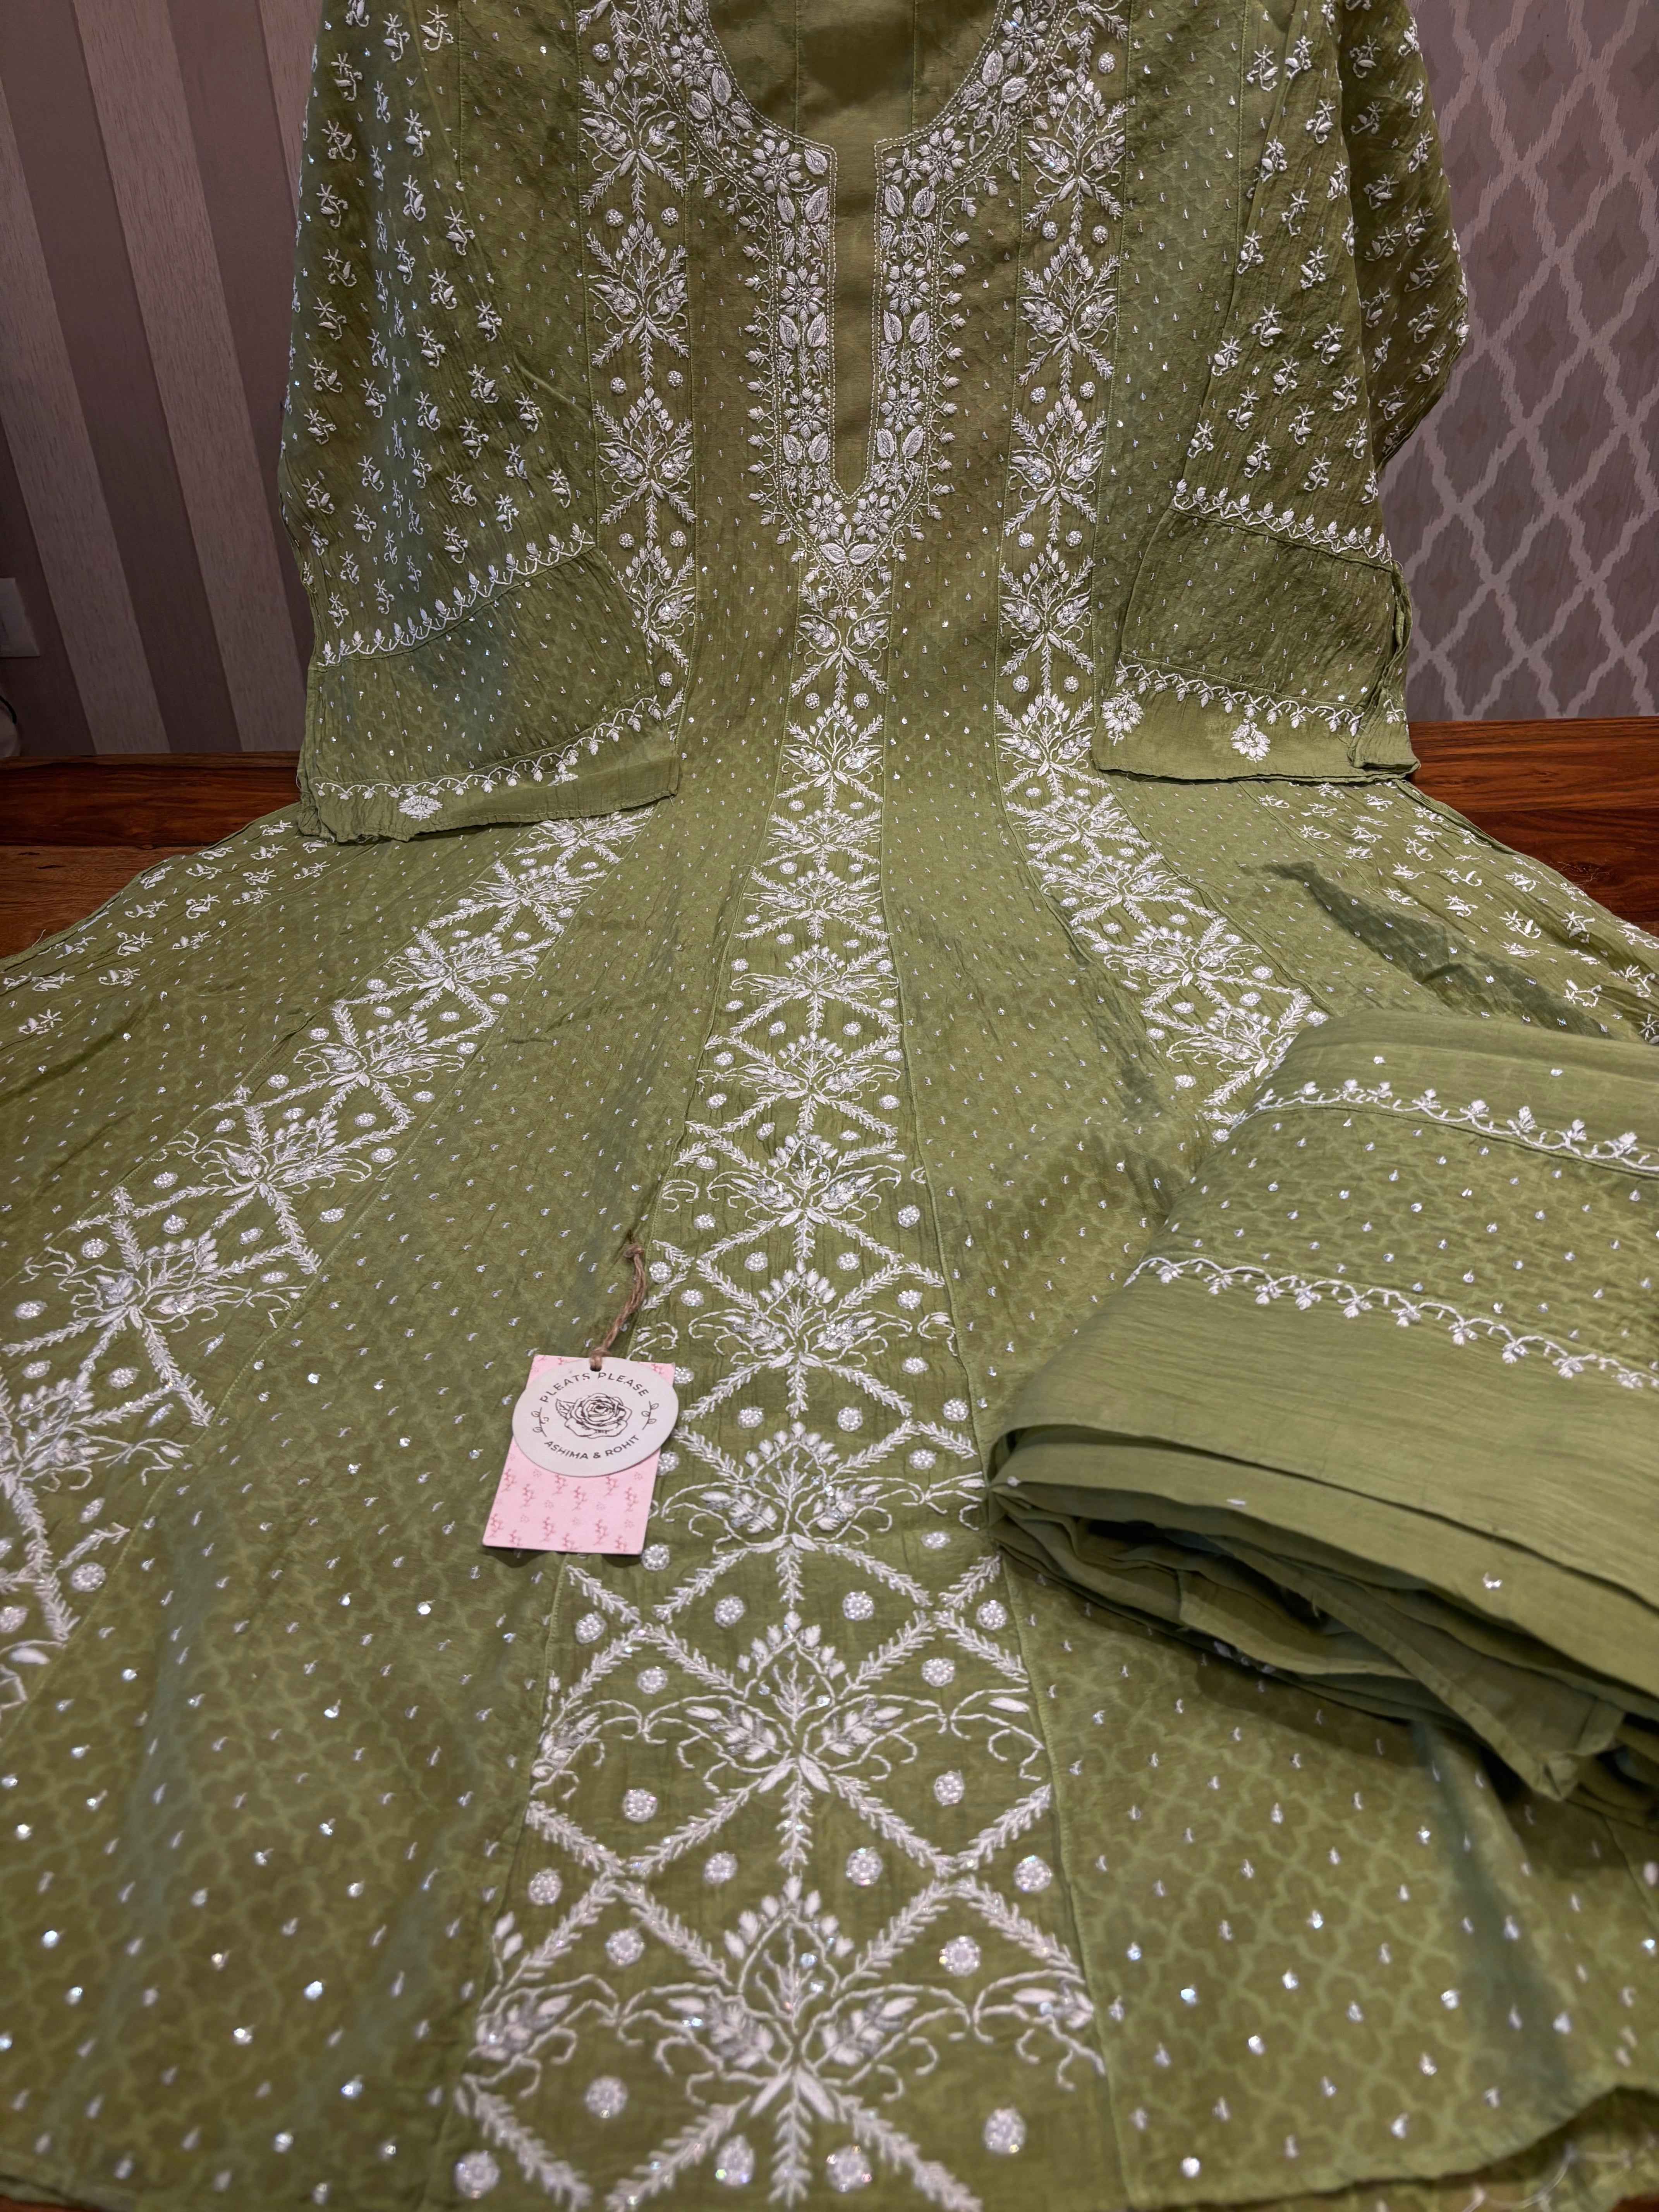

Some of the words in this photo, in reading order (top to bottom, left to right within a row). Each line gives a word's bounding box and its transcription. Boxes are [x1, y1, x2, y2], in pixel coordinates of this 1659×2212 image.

[540, 1372, 591, 1403] PLEATS
[598, 1372, 649, 1396] PLEASE
[544, 1440, 588, 1459] ASHIMA
[605, 1434, 639, 1456] ROHIT
